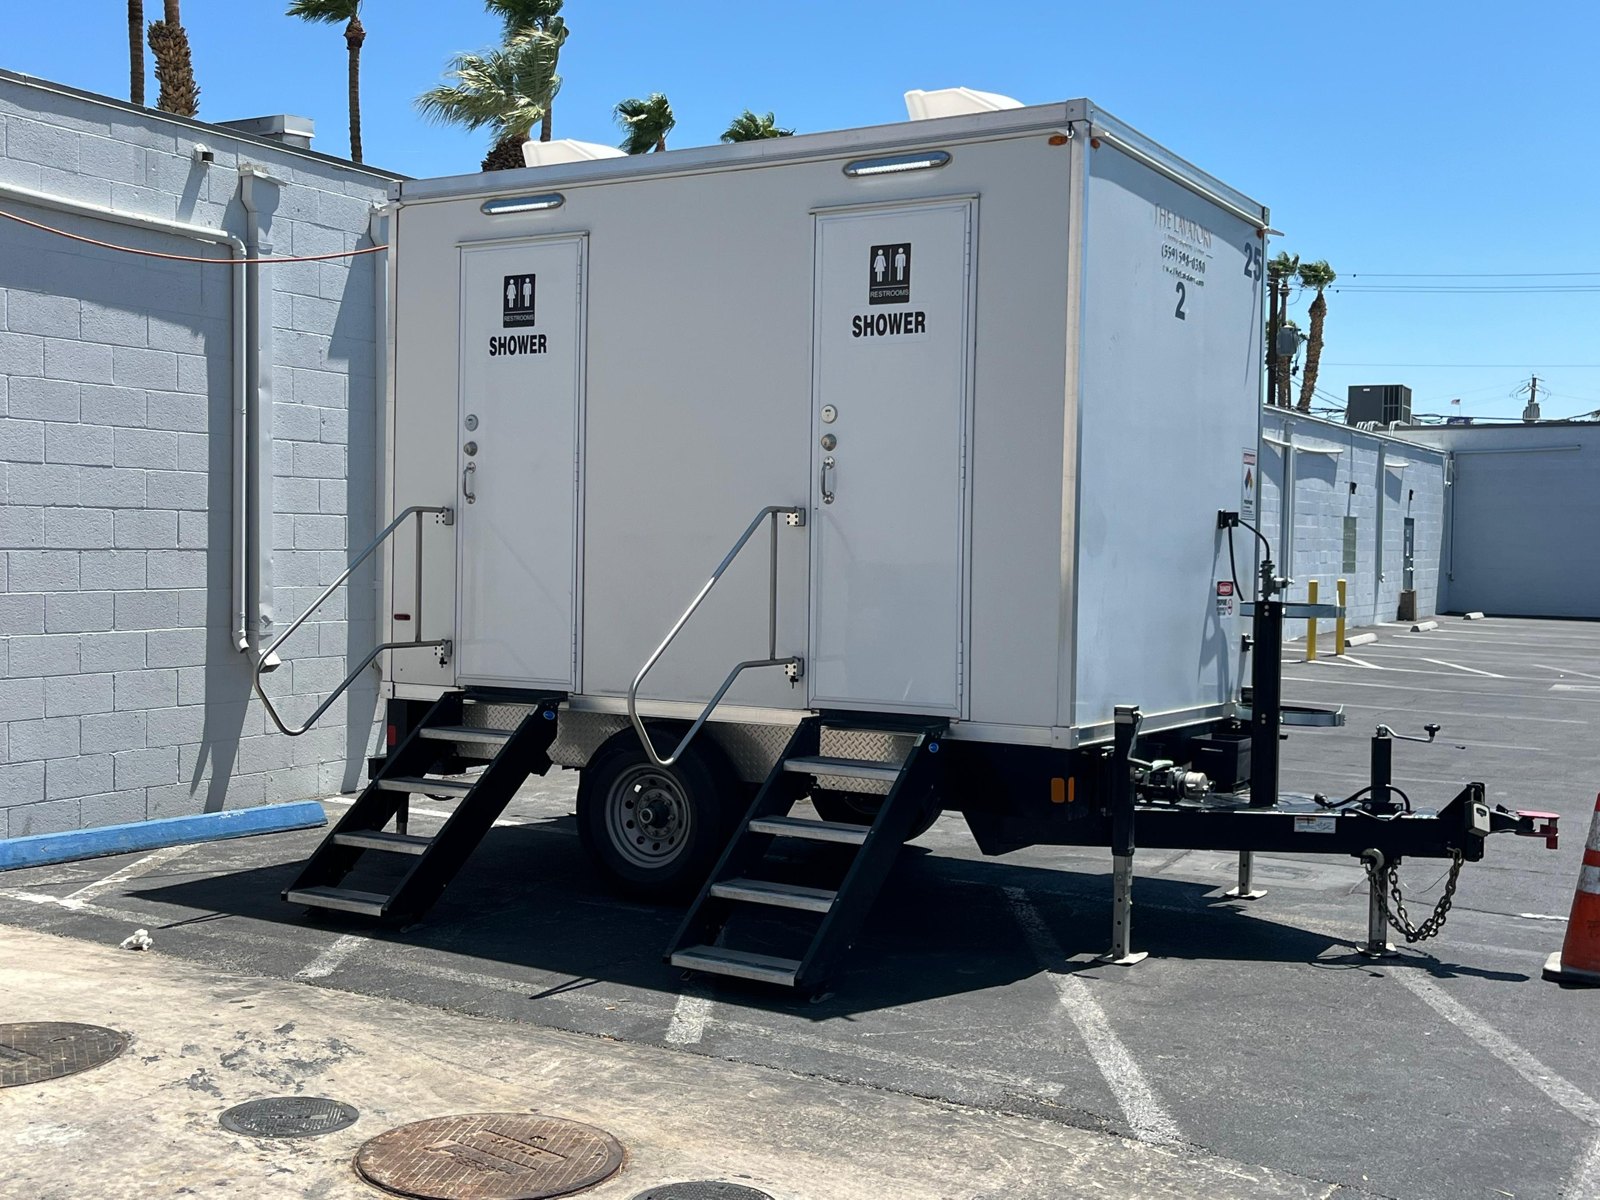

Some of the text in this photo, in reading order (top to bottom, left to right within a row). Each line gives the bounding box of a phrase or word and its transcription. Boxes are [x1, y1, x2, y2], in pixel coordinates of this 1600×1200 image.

[1154, 203, 1172, 230] THE
[1244, 242, 1261, 281] 25
[870, 289, 909, 298] RESTROOMS
[1175, 281, 1186, 320] 2
[503, 314, 535, 322] RESTROOMS
[852, 311, 926, 338] SHOWER
[489, 334, 547, 356] SHOWER
